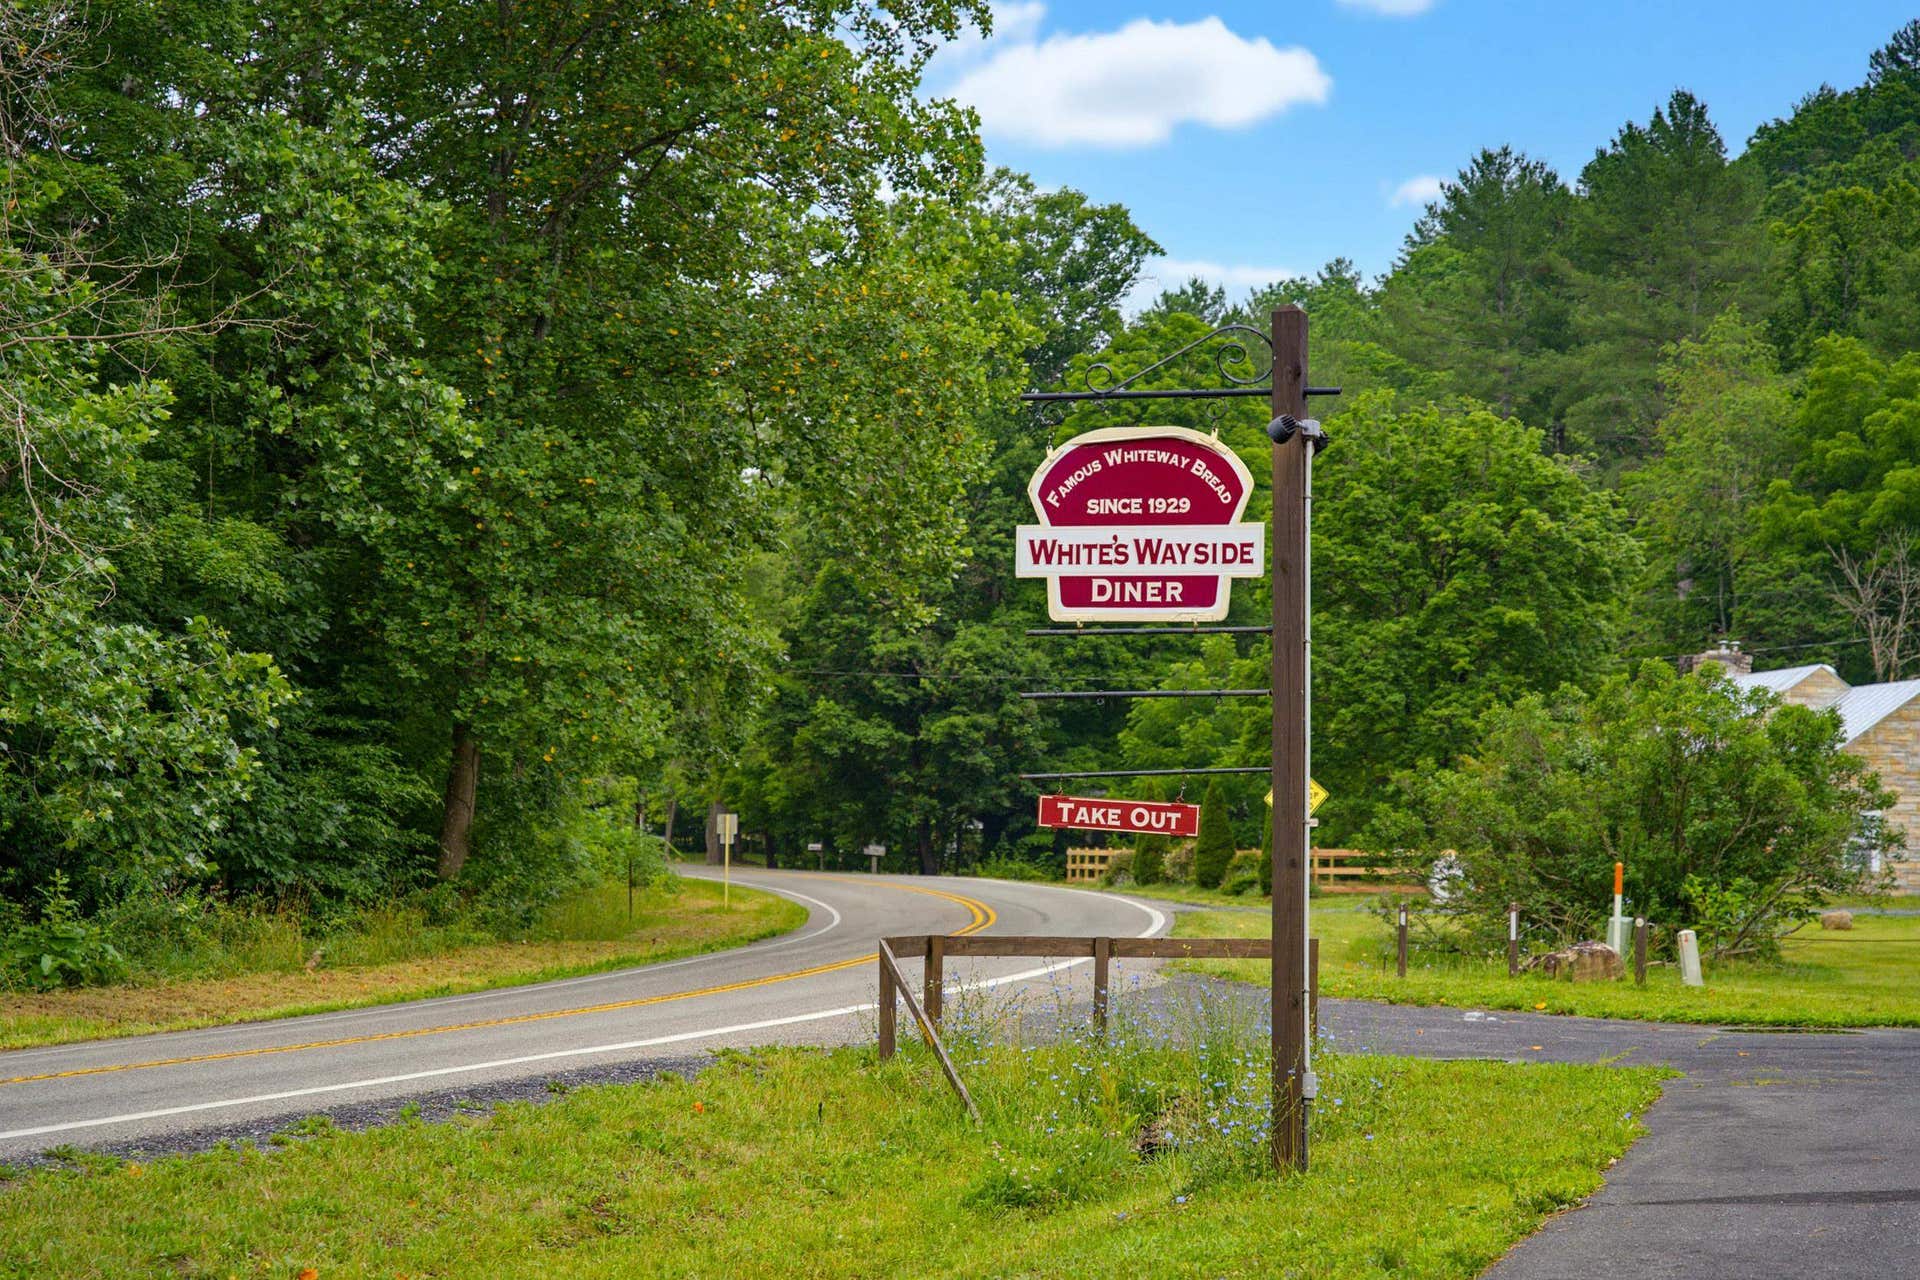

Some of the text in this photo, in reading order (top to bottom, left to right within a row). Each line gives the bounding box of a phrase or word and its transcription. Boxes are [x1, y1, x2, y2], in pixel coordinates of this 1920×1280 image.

[1046, 448, 1232, 508] FAMOUS WHITEWAY BREAD
[1087, 498, 1191, 514] SINCE 1929
[1029, 534, 1254, 565] WHITE'S WAYSIDE
[1091, 578, 1183, 602] DINER
[1057, 802, 1181, 829] TAKE OUT
